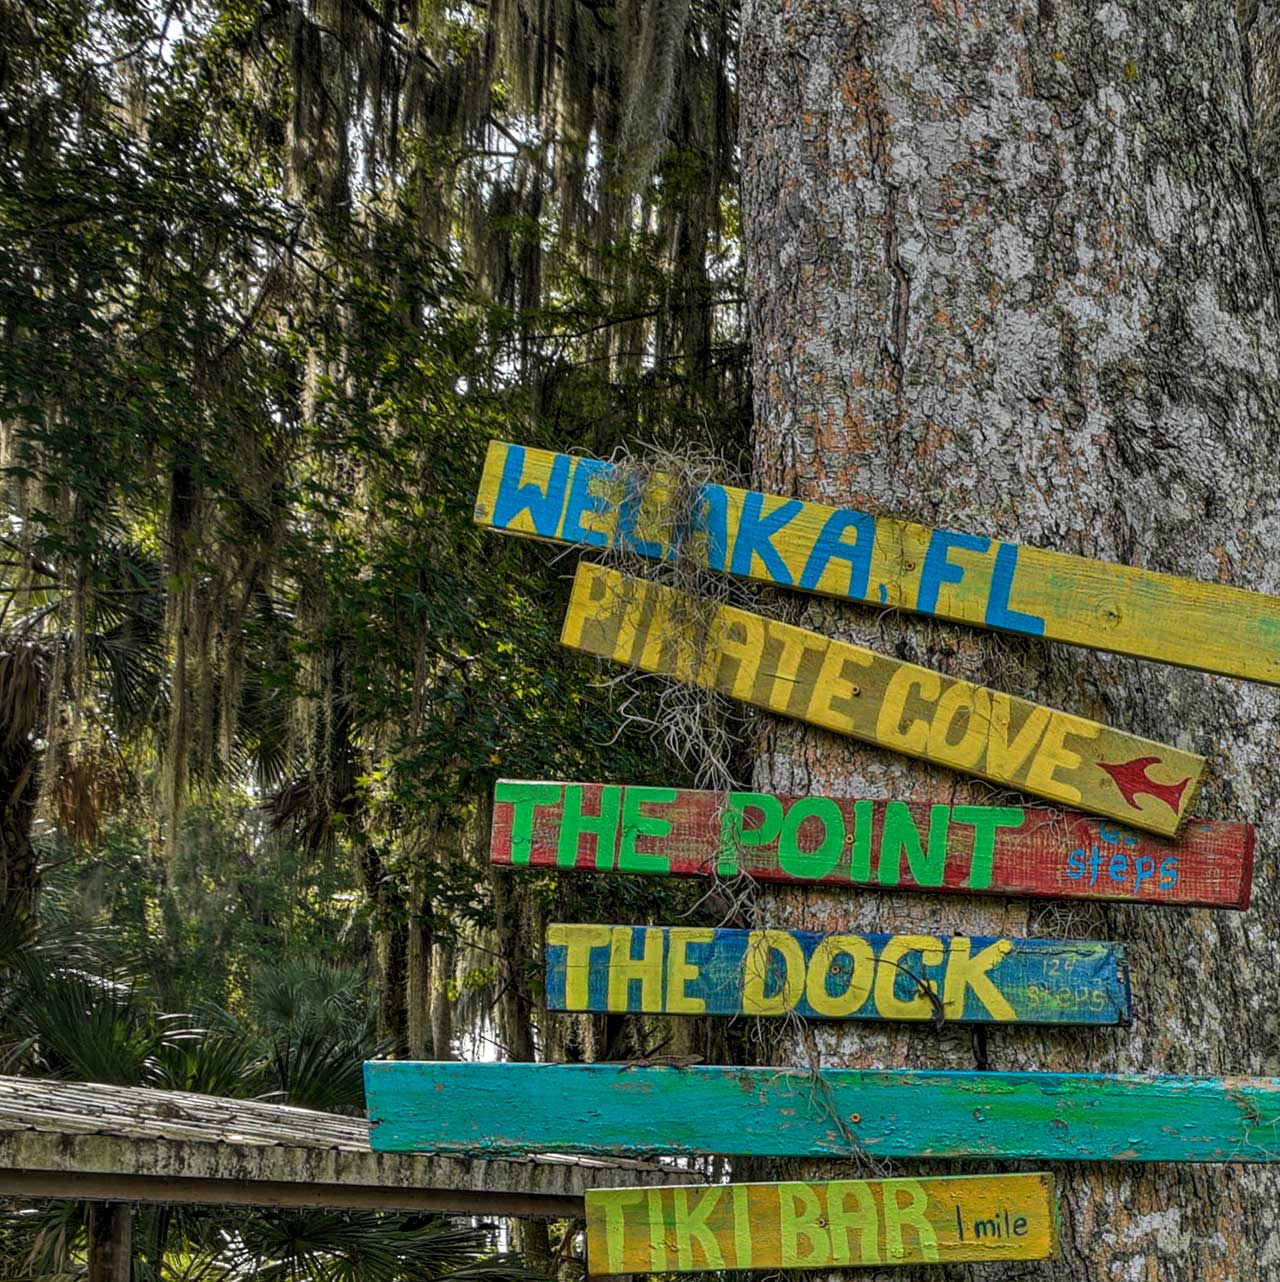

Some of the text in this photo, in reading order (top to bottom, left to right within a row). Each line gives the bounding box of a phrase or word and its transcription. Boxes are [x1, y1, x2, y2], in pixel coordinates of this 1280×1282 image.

[916, 528, 1045, 637] FL
[876, 666, 1099, 802] COVE
[495, 783, 1025, 889] THE POINT
[1066, 845, 1178, 893] steps
[546, 924, 1017, 1021] THE DOCK
[586, 1185, 751, 1274] TIKI
[778, 1178, 939, 1266] BAR
[974, 1208, 1028, 1239] mile
